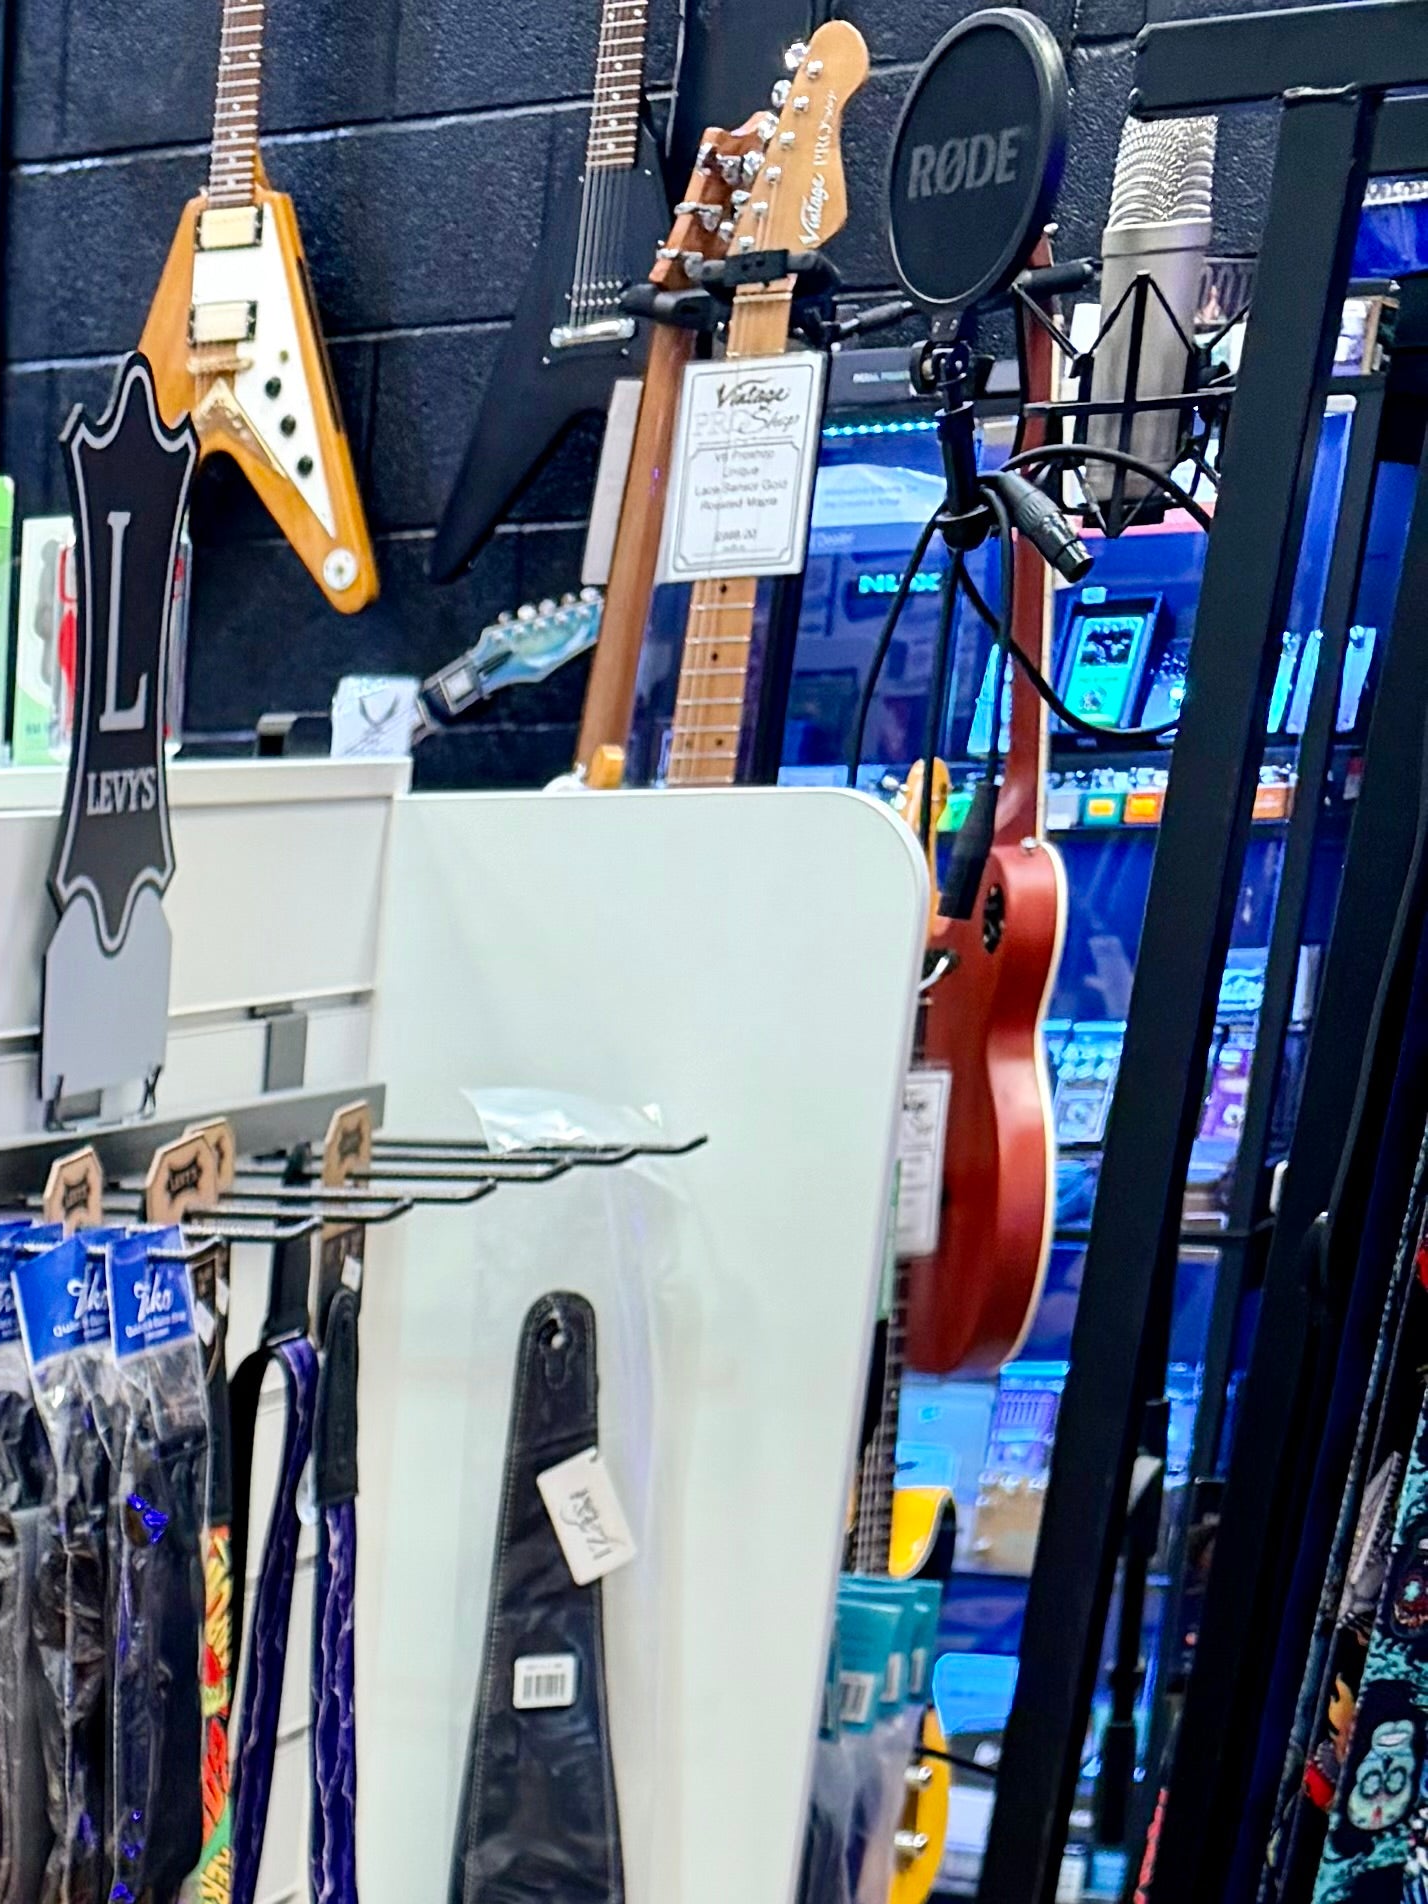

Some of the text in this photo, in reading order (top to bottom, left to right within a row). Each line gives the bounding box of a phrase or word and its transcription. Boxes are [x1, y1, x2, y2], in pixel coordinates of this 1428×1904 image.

[907, 125, 1022, 200] RØDE
[717, 377, 789, 411] Vintage
[99, 511, 148, 733] L
[87, 768, 157, 816] LEVY'S
